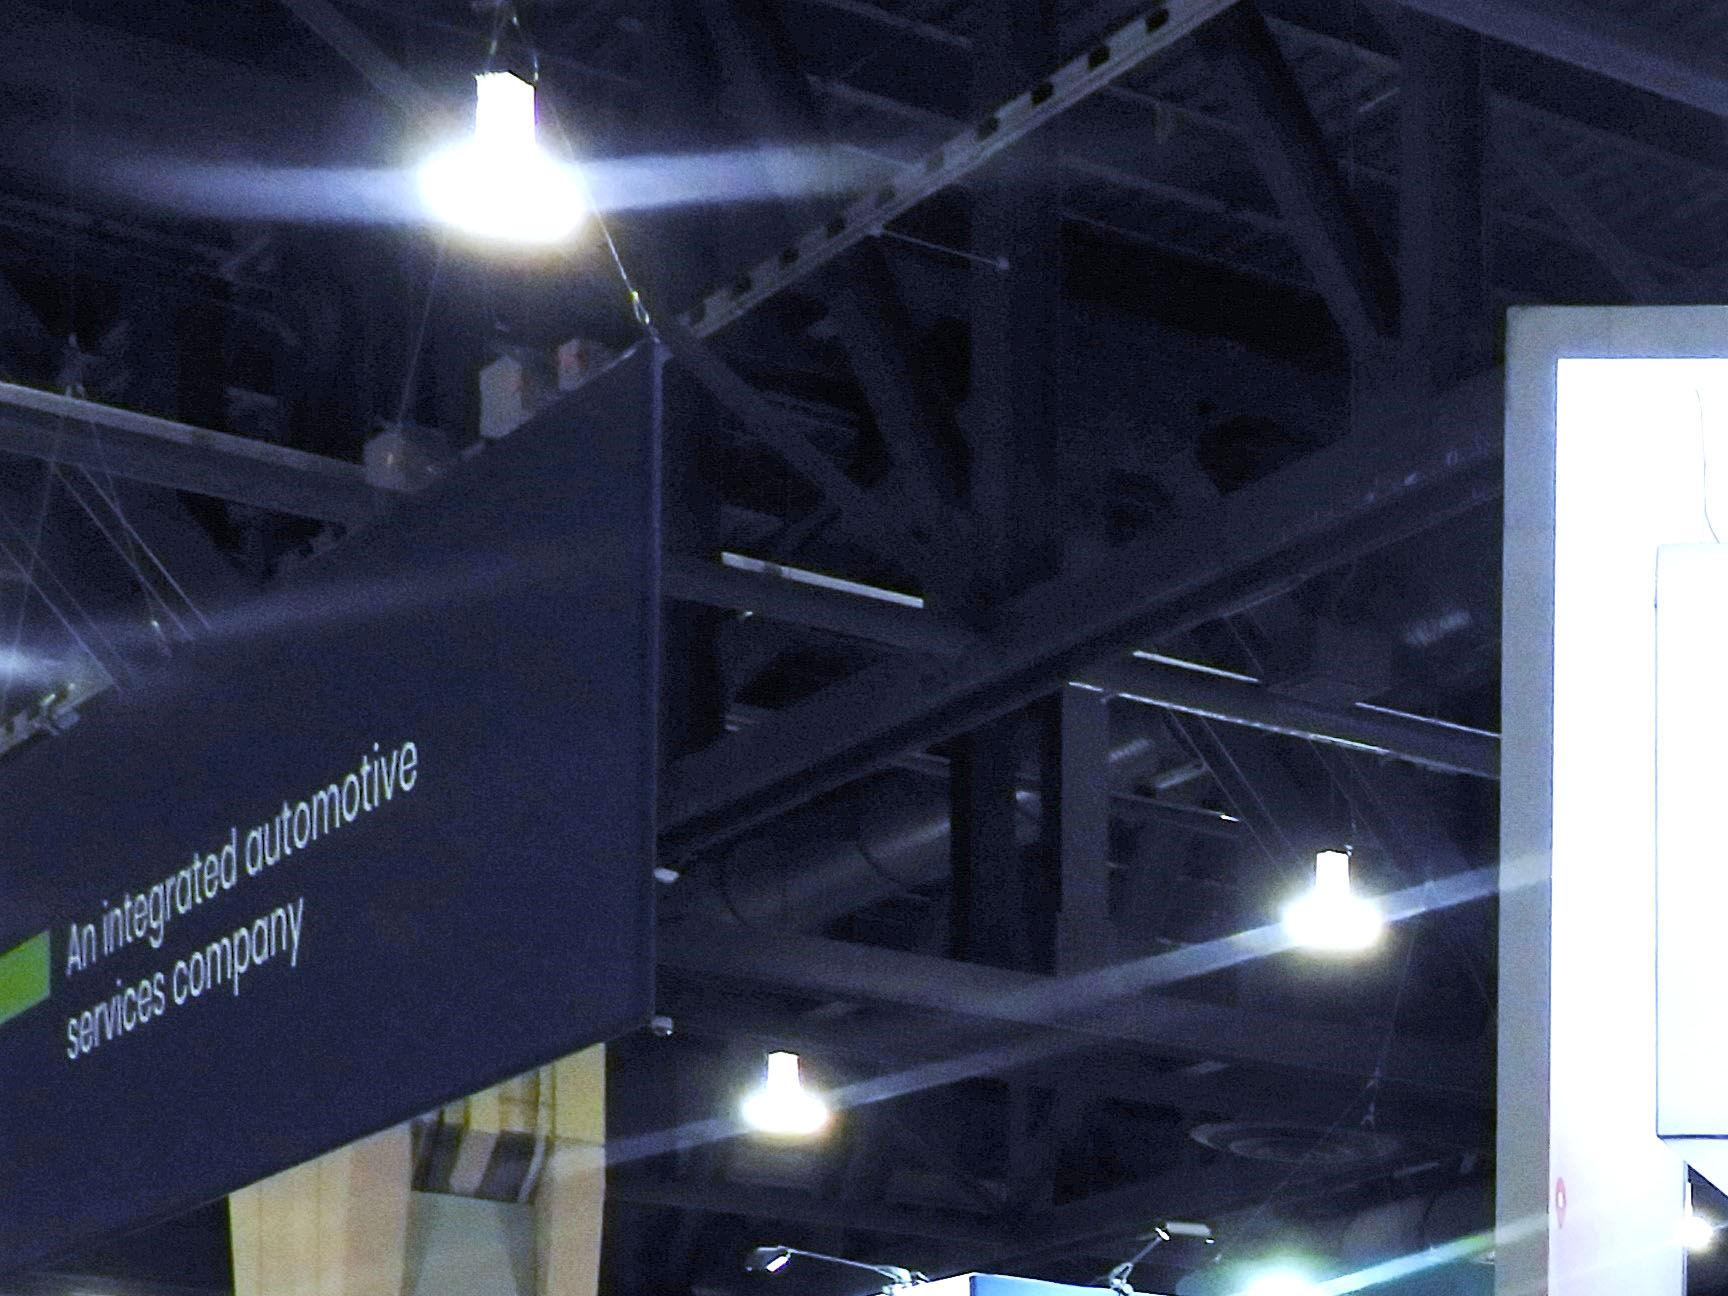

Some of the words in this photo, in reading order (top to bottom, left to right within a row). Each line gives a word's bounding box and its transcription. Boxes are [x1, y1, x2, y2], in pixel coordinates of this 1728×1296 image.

[66, 922, 97, 977] An
[103, 826, 238, 956] integrated
[246, 741, 418, 876] automotive
[66, 972, 166, 1060] services
[173, 897, 304, 1005] company
